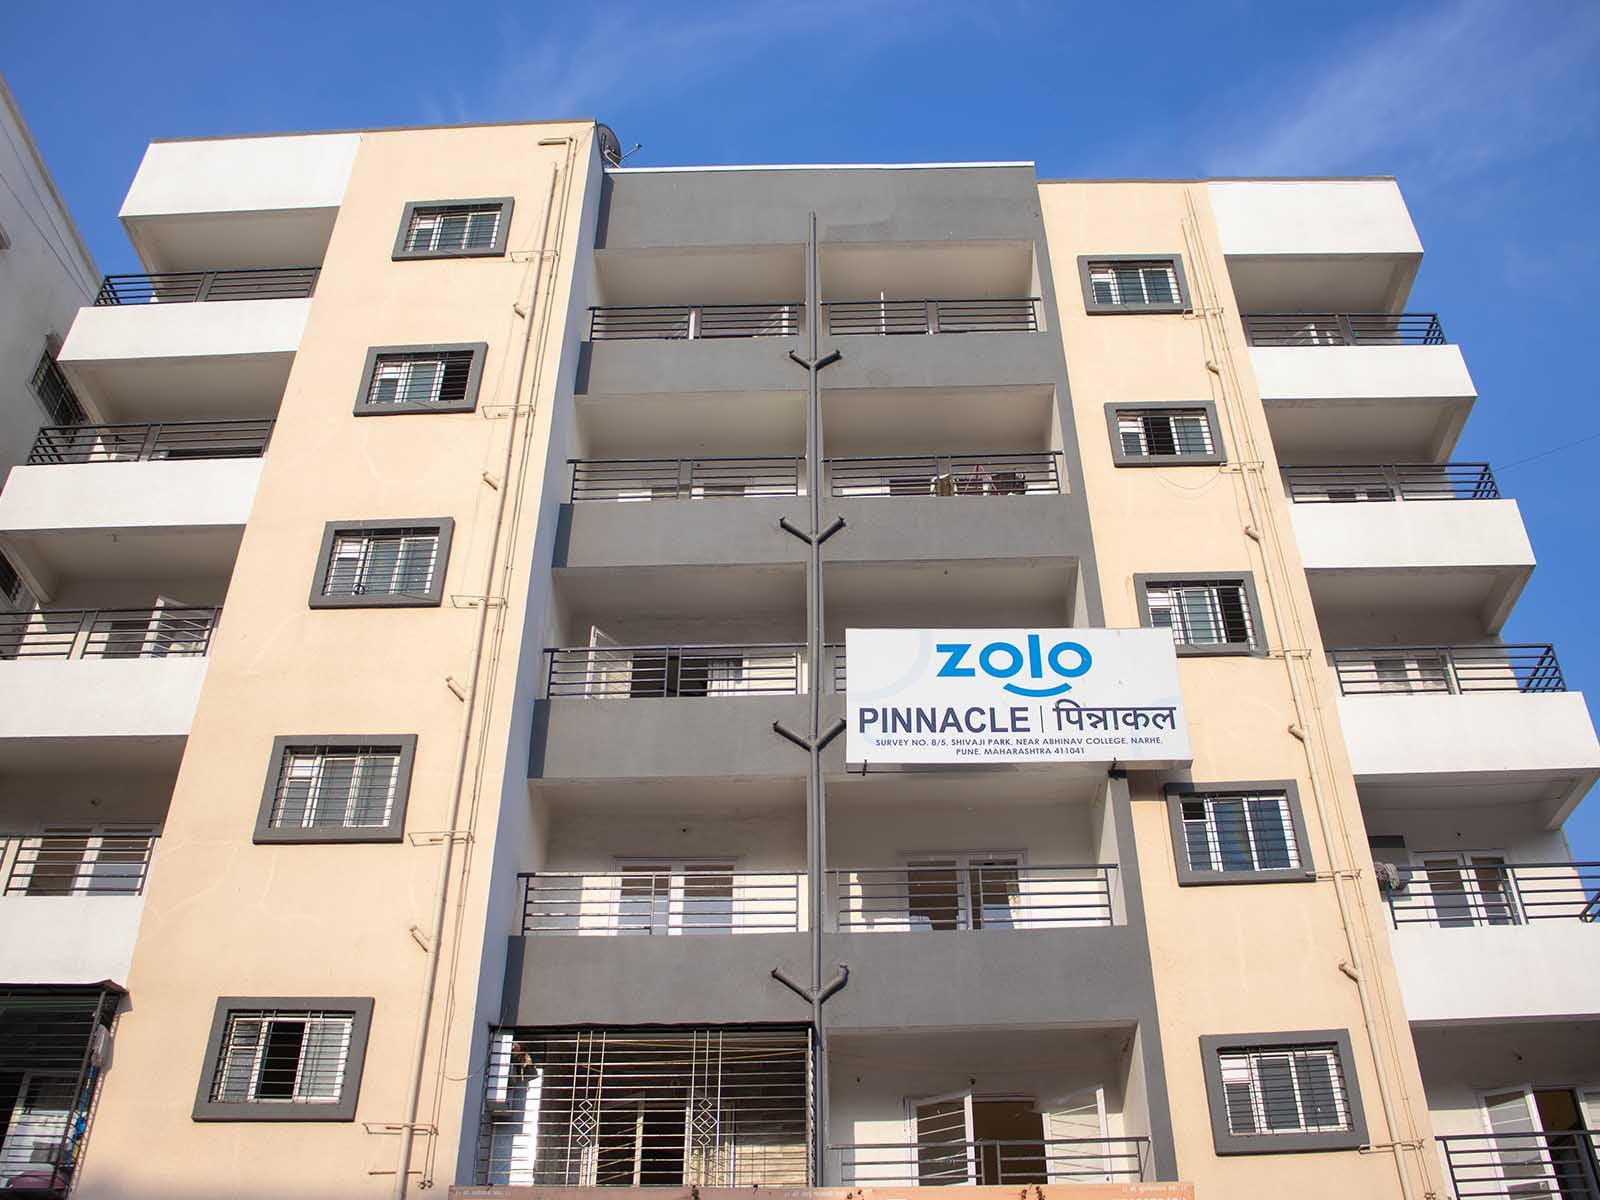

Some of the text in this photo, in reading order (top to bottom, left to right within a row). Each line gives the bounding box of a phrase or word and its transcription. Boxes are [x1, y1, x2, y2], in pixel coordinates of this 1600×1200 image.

[936, 634, 1093, 679] zolo
[859, 706, 1031, 734] PINNACLE
[876, 738, 909, 747] SURVEY
[912, 738, 929, 747] NO.
[951, 738, 986, 747] SHIVAJI
[1016, 737, 1040, 747] NEAR
[1043, 737, 1083, 746] ABHINAV
[984, 747, 1052, 756] MAHARASHTRA
[1054, 747, 1085, 755] 411041
